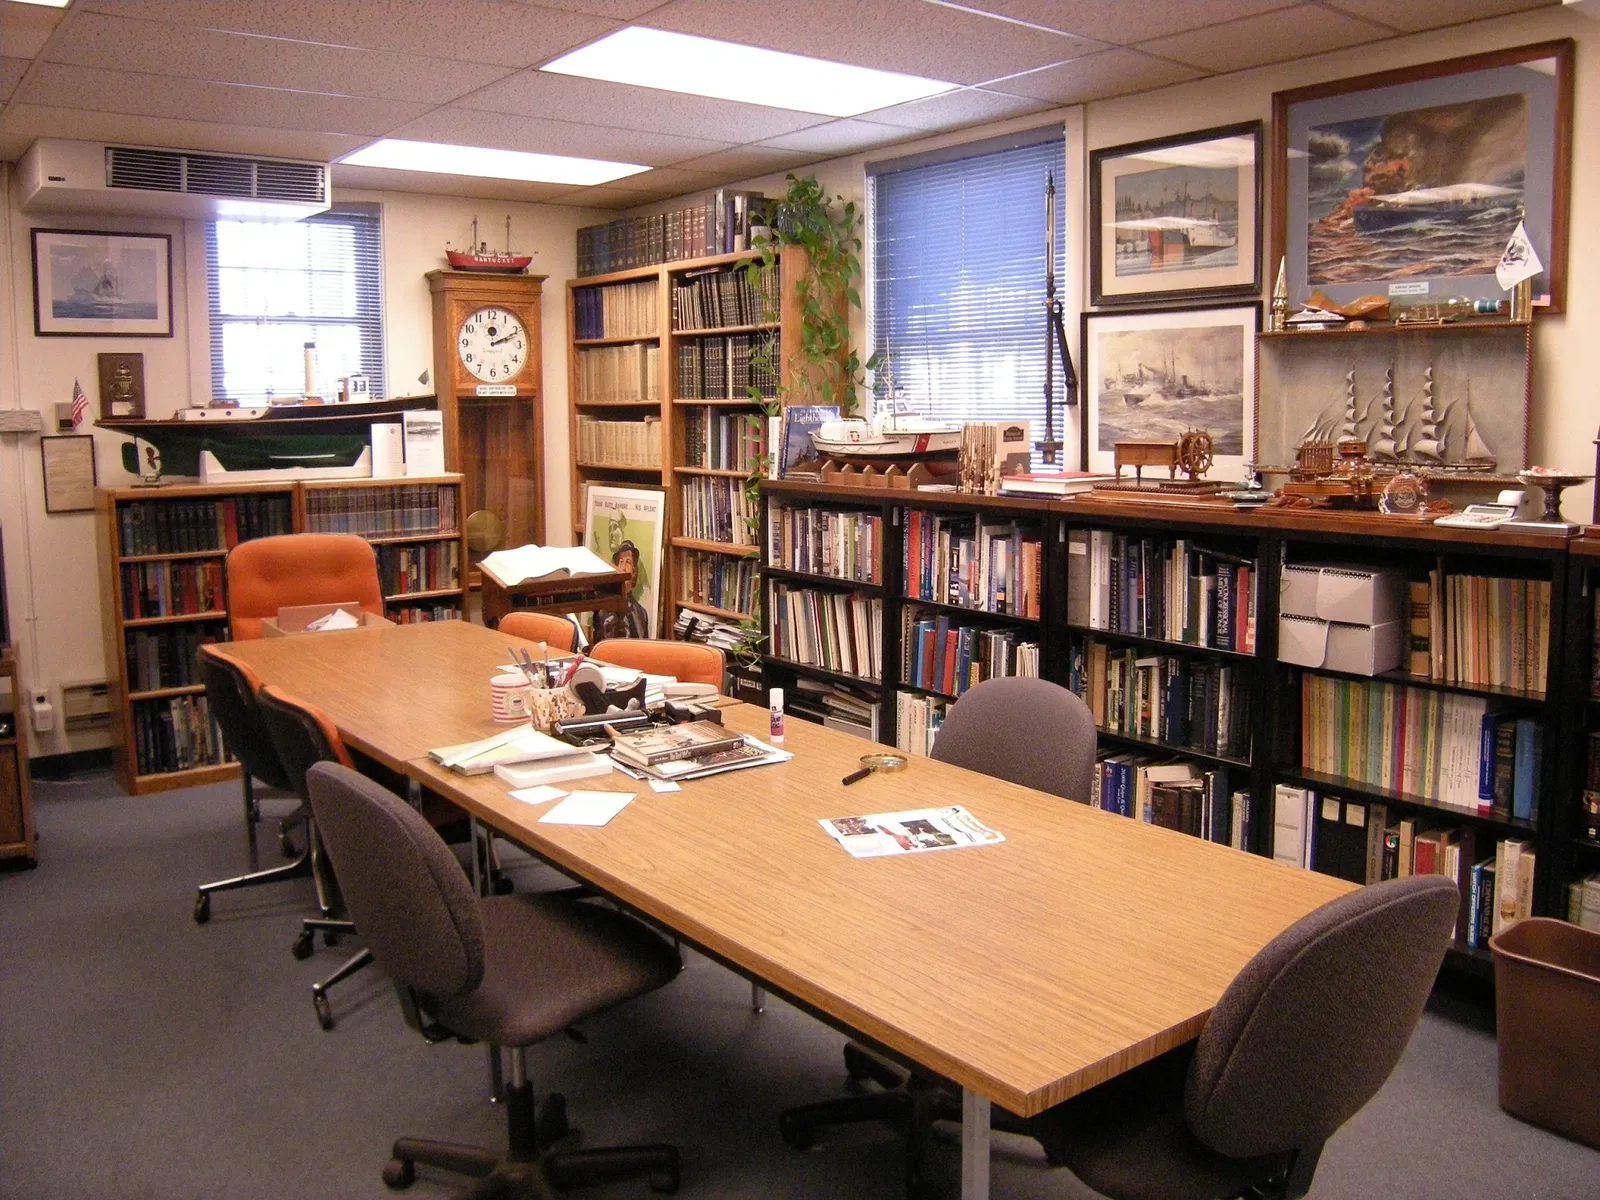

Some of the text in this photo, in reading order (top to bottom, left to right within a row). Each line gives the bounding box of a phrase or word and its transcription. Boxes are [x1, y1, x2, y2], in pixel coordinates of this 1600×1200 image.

[475, 314, 482, 323] 11
[488, 311, 497, 320] 12
[504, 315, 507, 324] 1
[465, 324, 474, 333] 10
[512, 326, 518, 335] 2
[462, 339, 469, 348] 9
[516, 340, 522, 349] 3
[466, 354, 472, 363] 8
[512, 355, 518, 363] 4
[477, 364, 482, 373] 7
[490, 368, 496, 377] 6
[503, 365, 509, 374] 5
